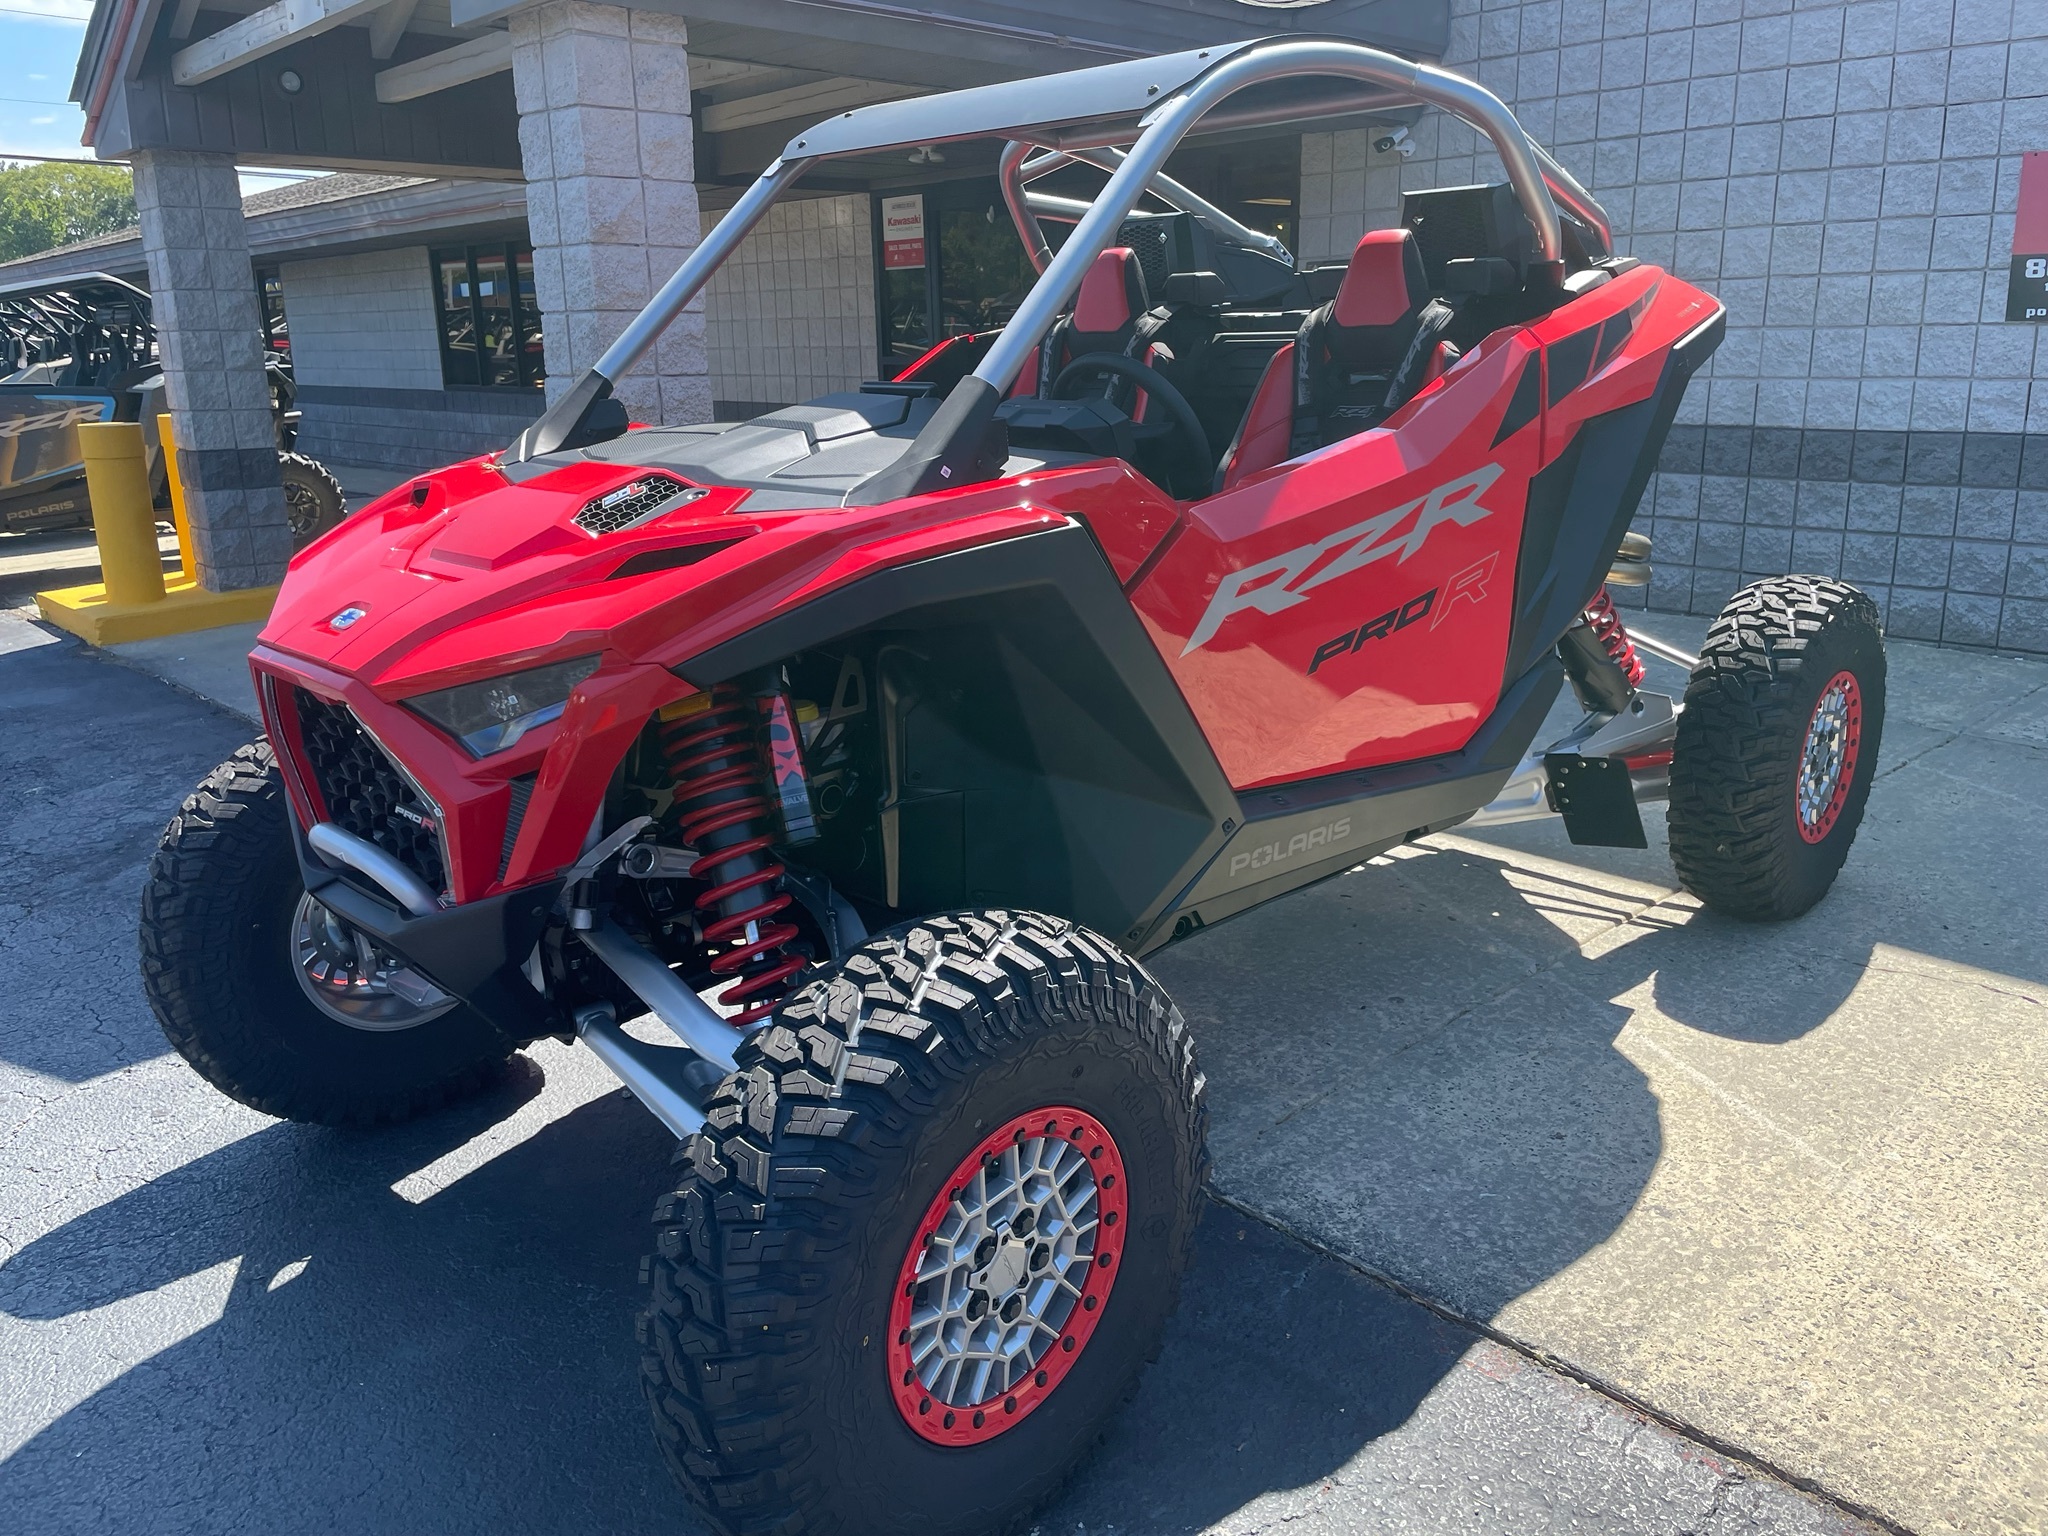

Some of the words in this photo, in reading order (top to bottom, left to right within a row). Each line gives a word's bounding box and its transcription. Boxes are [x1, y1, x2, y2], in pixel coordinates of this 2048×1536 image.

[887, 214, 922, 227] Kawasaki
[2025, 258, 2048, 278] 8
[6, 500, 75, 521] POLARIS
[1178, 462, 1506, 660] RZR
[1229, 817, 1350, 877] POLARIS
